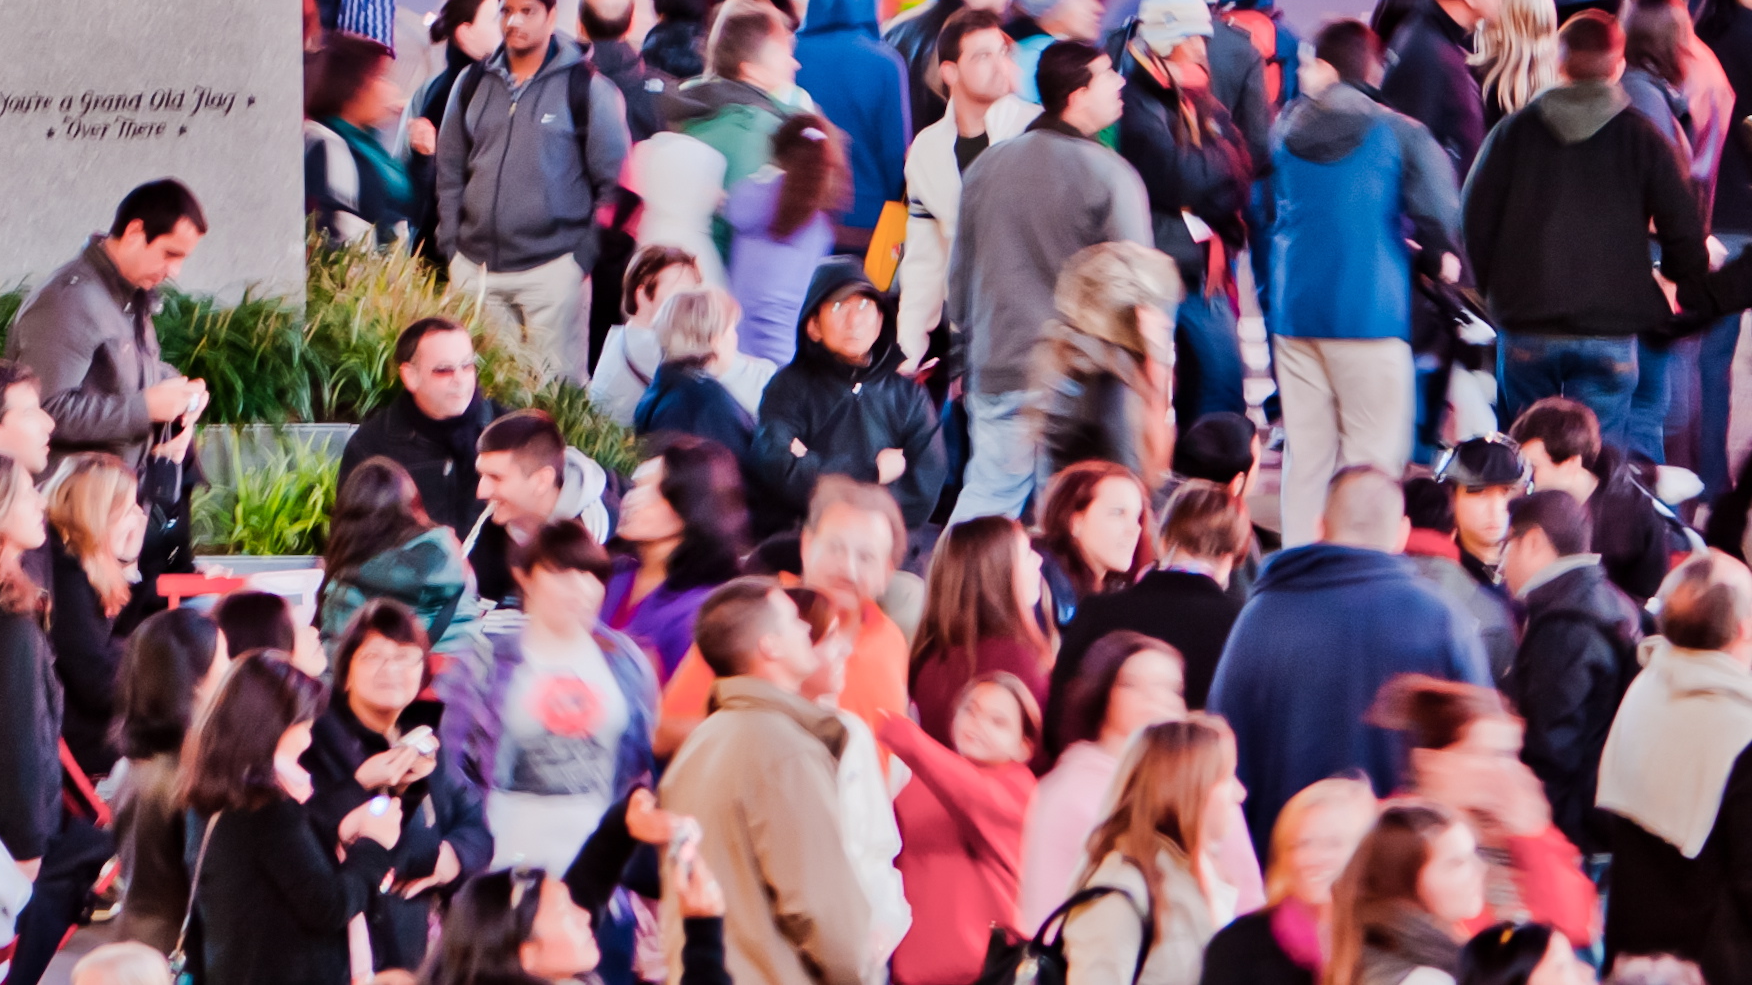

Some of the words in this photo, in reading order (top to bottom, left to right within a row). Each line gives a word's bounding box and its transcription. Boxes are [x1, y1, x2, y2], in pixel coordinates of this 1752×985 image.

[59, 94, 73, 112] a
[79, 89, 144, 117] Grand
[149, 88, 186, 112] Old
[192, 85, 238, 117] Flag
[63, 115, 111, 141] Over
[114, 115, 168, 141] There
